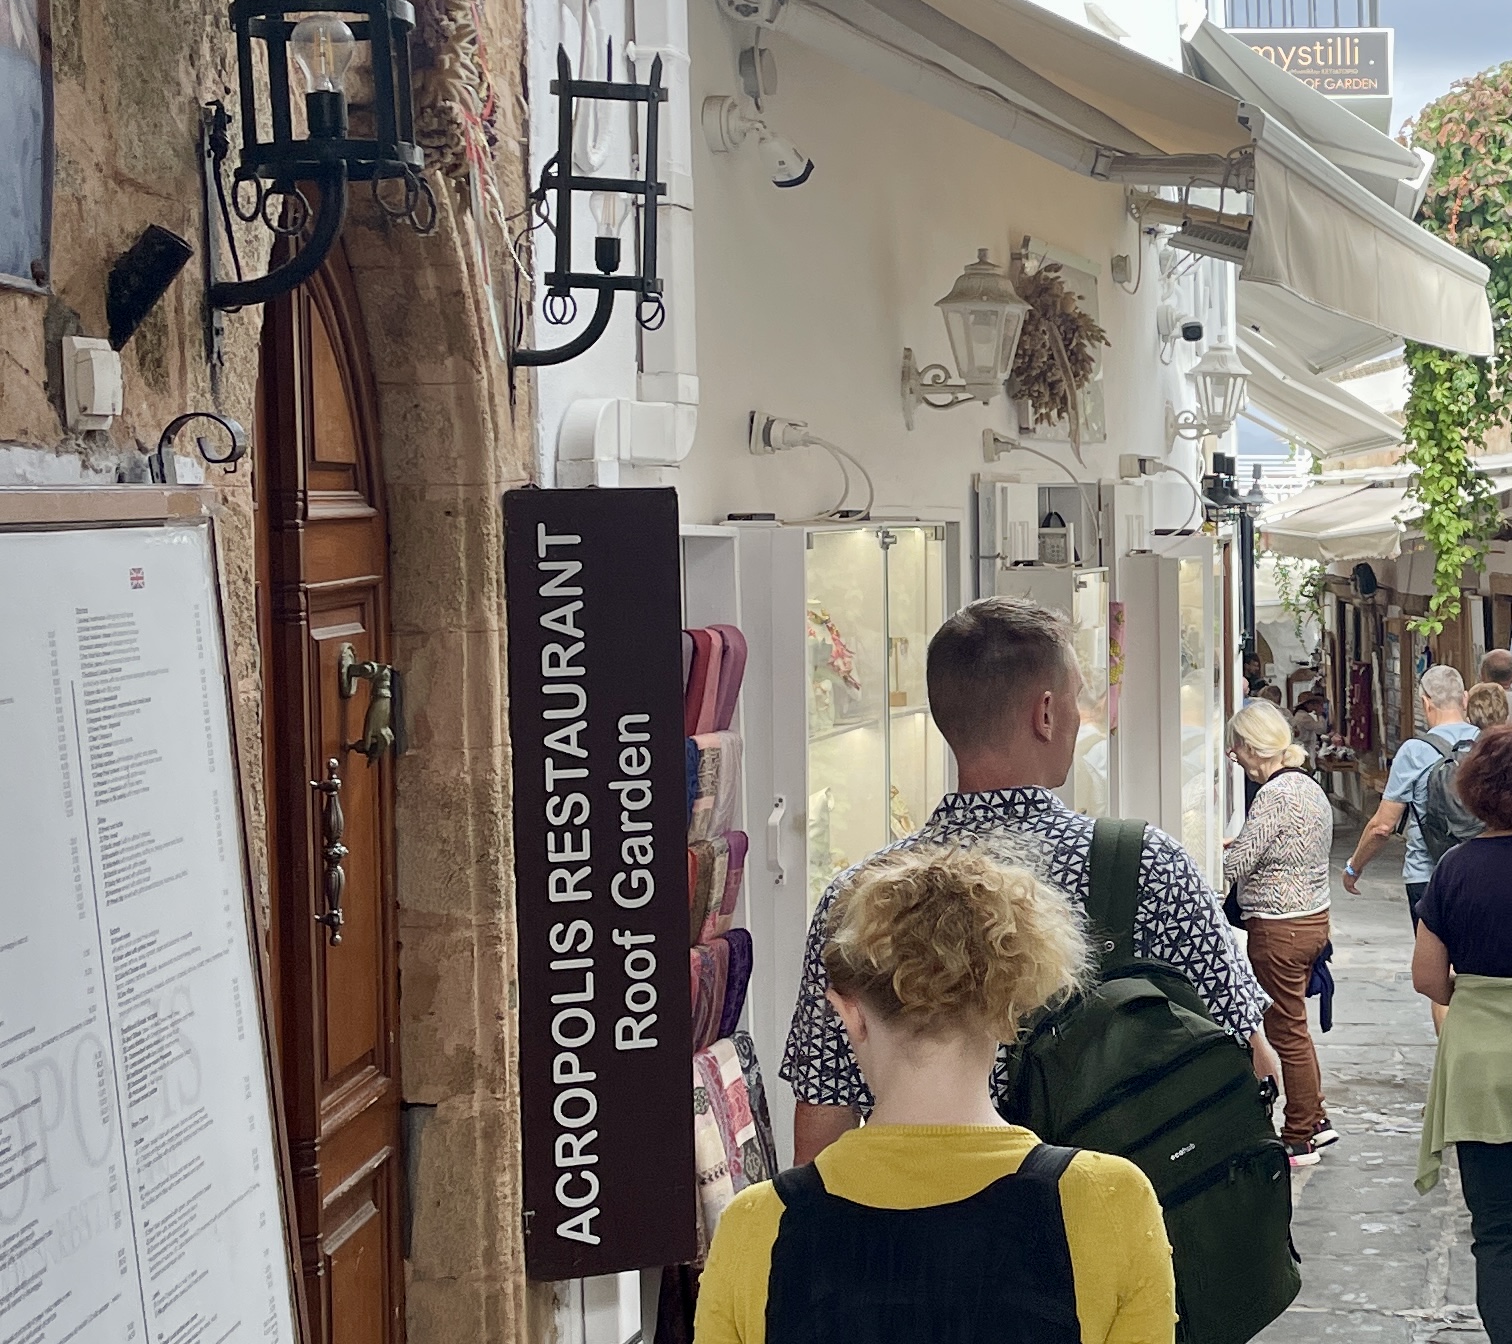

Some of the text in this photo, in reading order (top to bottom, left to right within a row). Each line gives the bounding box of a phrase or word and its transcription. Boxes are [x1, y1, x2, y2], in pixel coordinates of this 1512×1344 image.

[1324, 77, 1378, 90] GARDEN
[538, 523, 600, 1245] ACROPOLIS RESTAURANT
[608, 713, 658, 1050] Roof Garden
